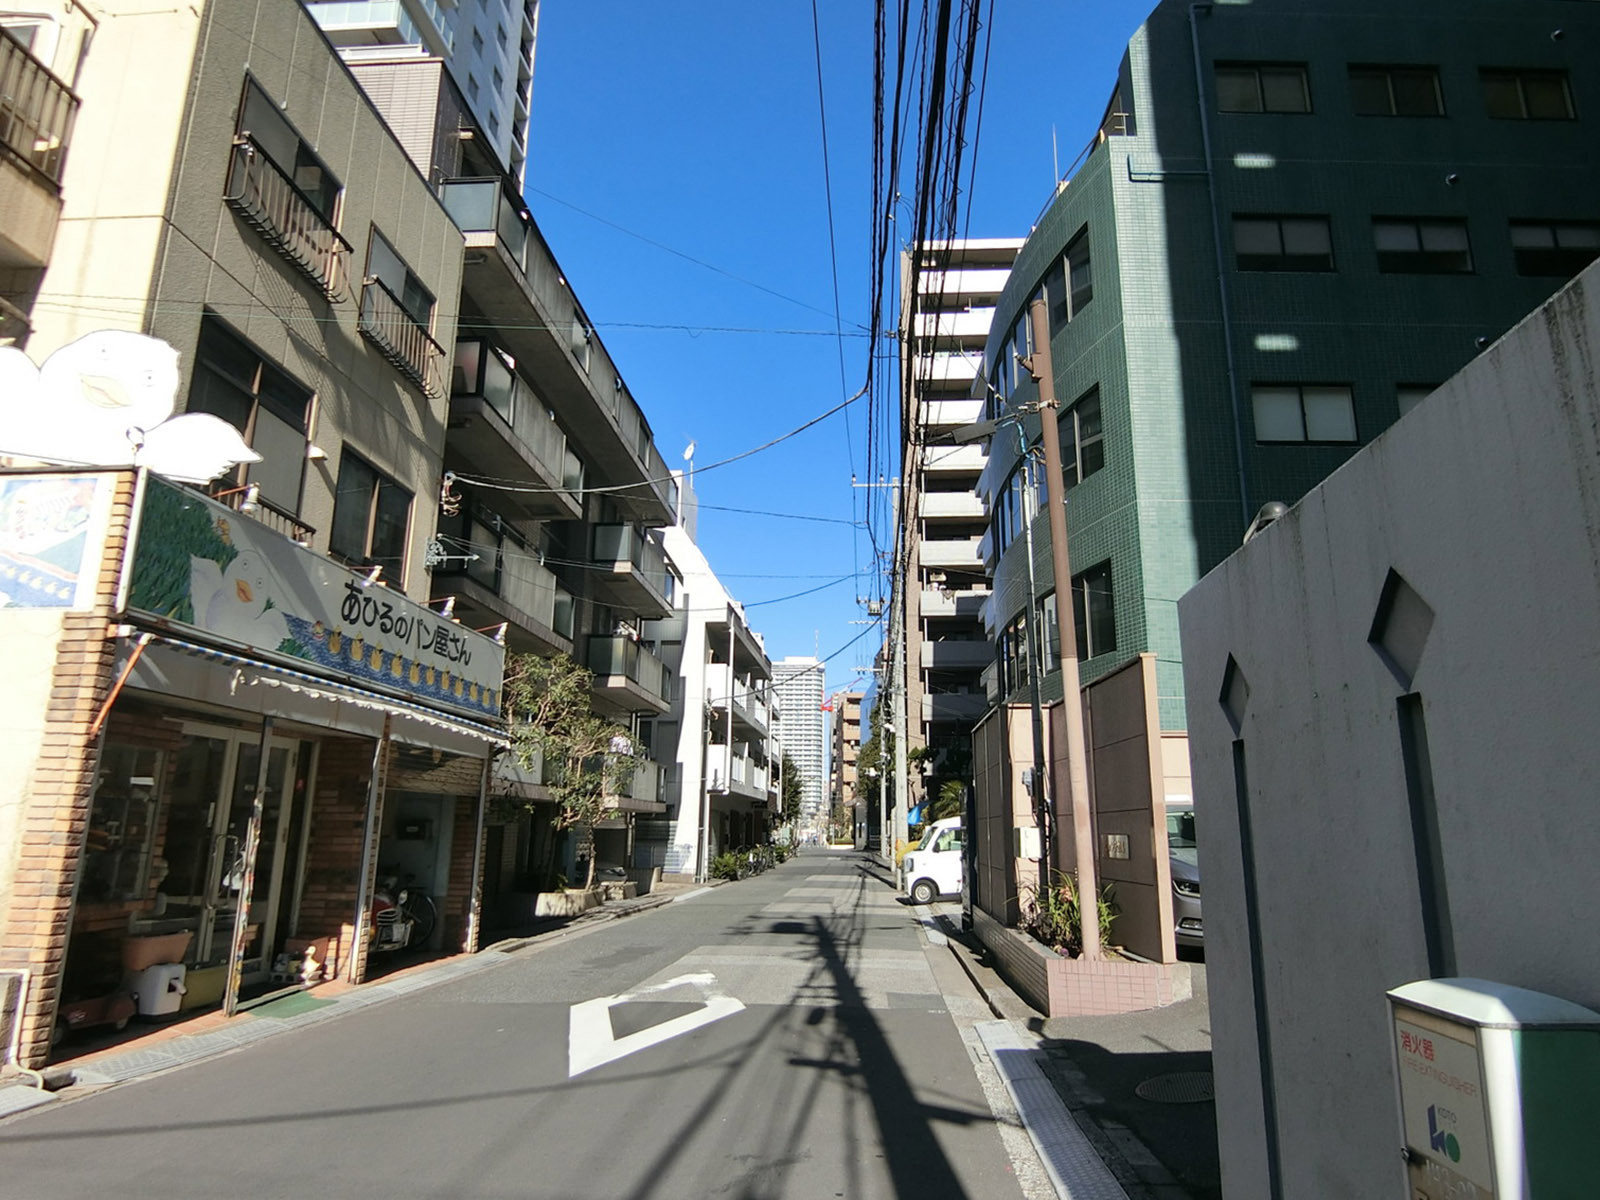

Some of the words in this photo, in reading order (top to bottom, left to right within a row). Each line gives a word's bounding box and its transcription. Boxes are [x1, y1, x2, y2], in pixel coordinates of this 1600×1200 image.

[341, 579, 472, 666] あひるのパン屋さん
[1401, 1029, 1435, 1062] 消火器
[1437, 1106, 1457, 1124] KOTO
